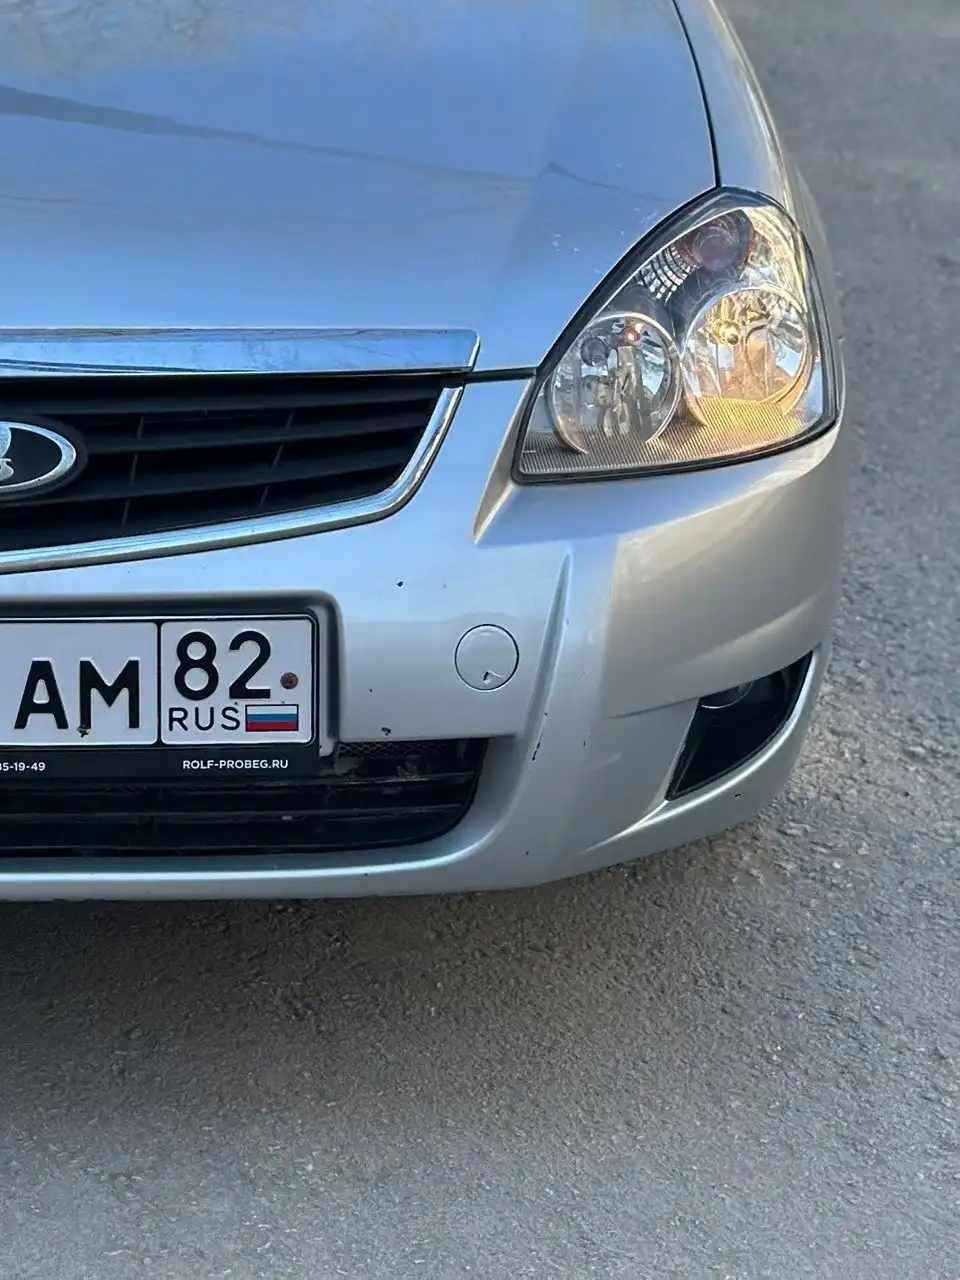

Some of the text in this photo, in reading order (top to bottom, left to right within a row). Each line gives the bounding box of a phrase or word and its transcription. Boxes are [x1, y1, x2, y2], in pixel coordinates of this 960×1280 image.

[173, 630, 271, 702] 82
[167, 705, 242, 733] RUS
[181, 759, 289, 770] ROLF-PROBEG.RU
